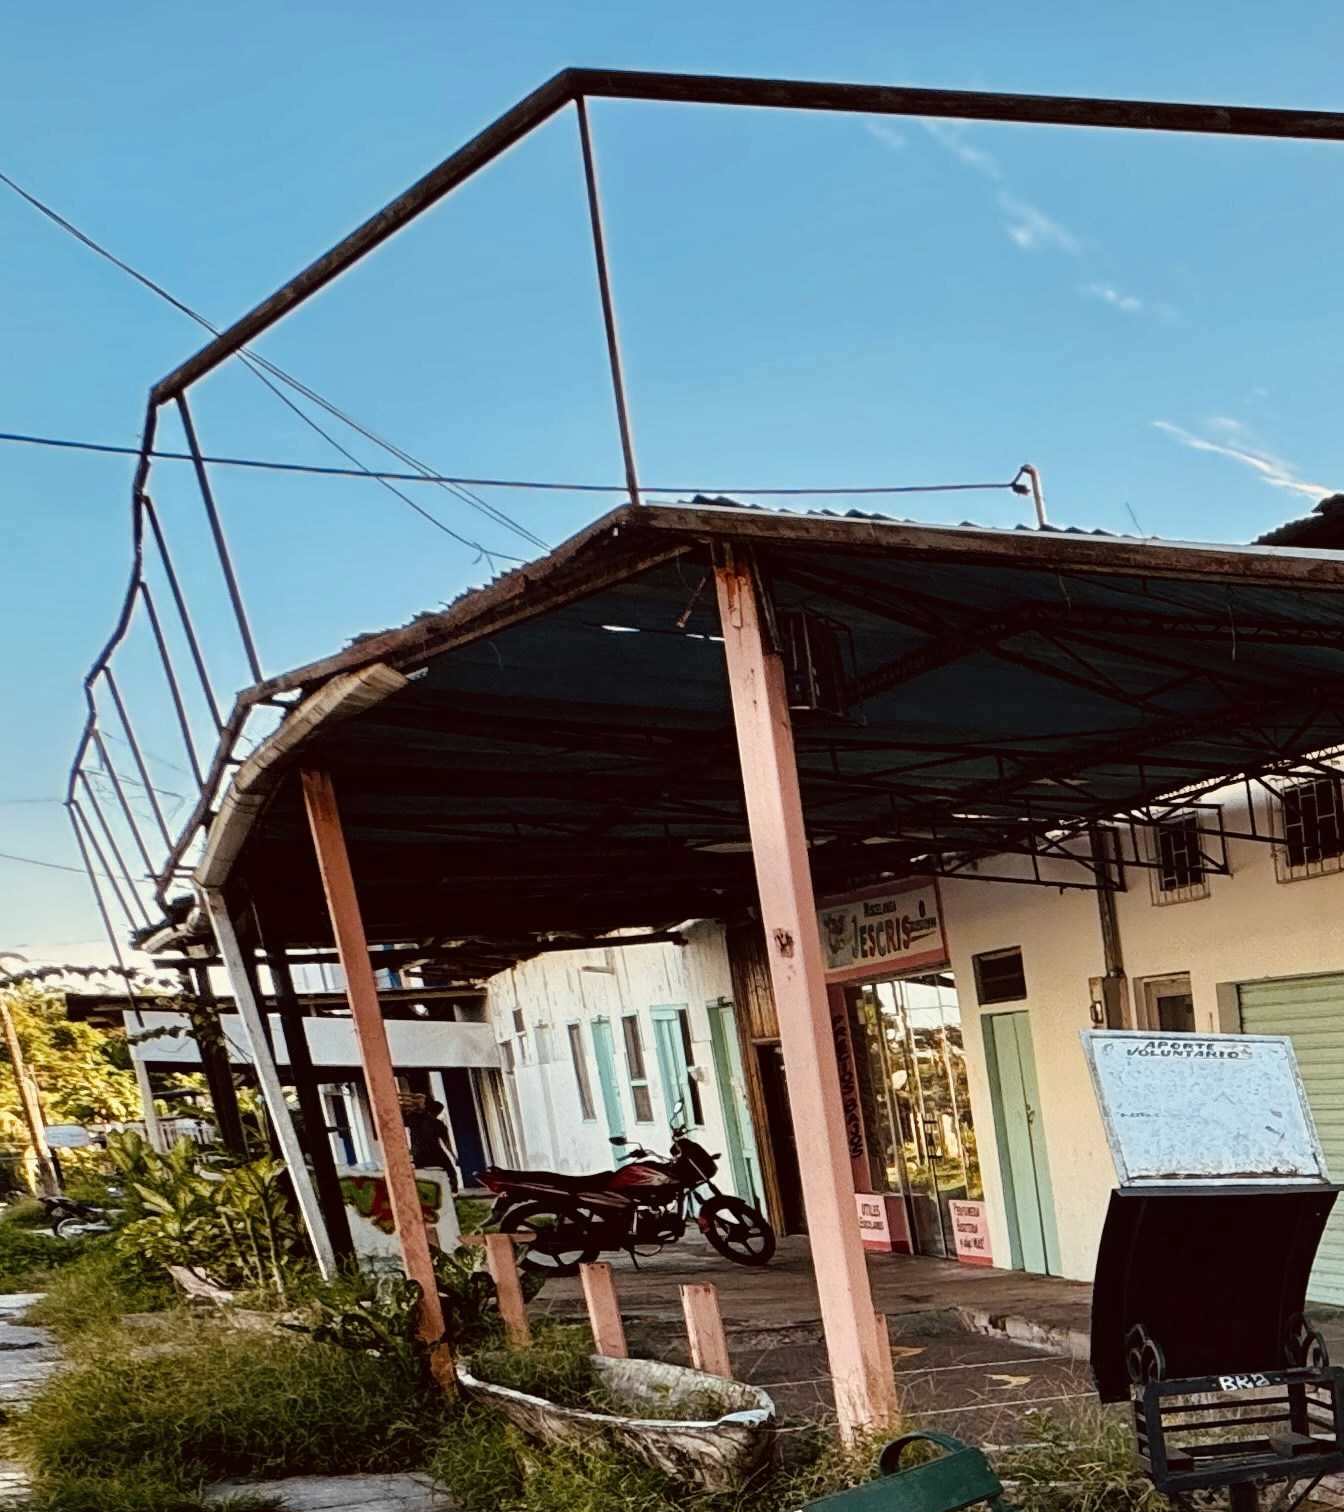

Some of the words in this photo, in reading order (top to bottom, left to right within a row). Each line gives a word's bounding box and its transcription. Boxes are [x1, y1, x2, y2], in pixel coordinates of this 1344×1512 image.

[852, 915, 911, 959] JESCRIS
[1144, 1040, 1215, 1051] APORTE
[1126, 1048, 1240, 1060] VOLUNTARIO
